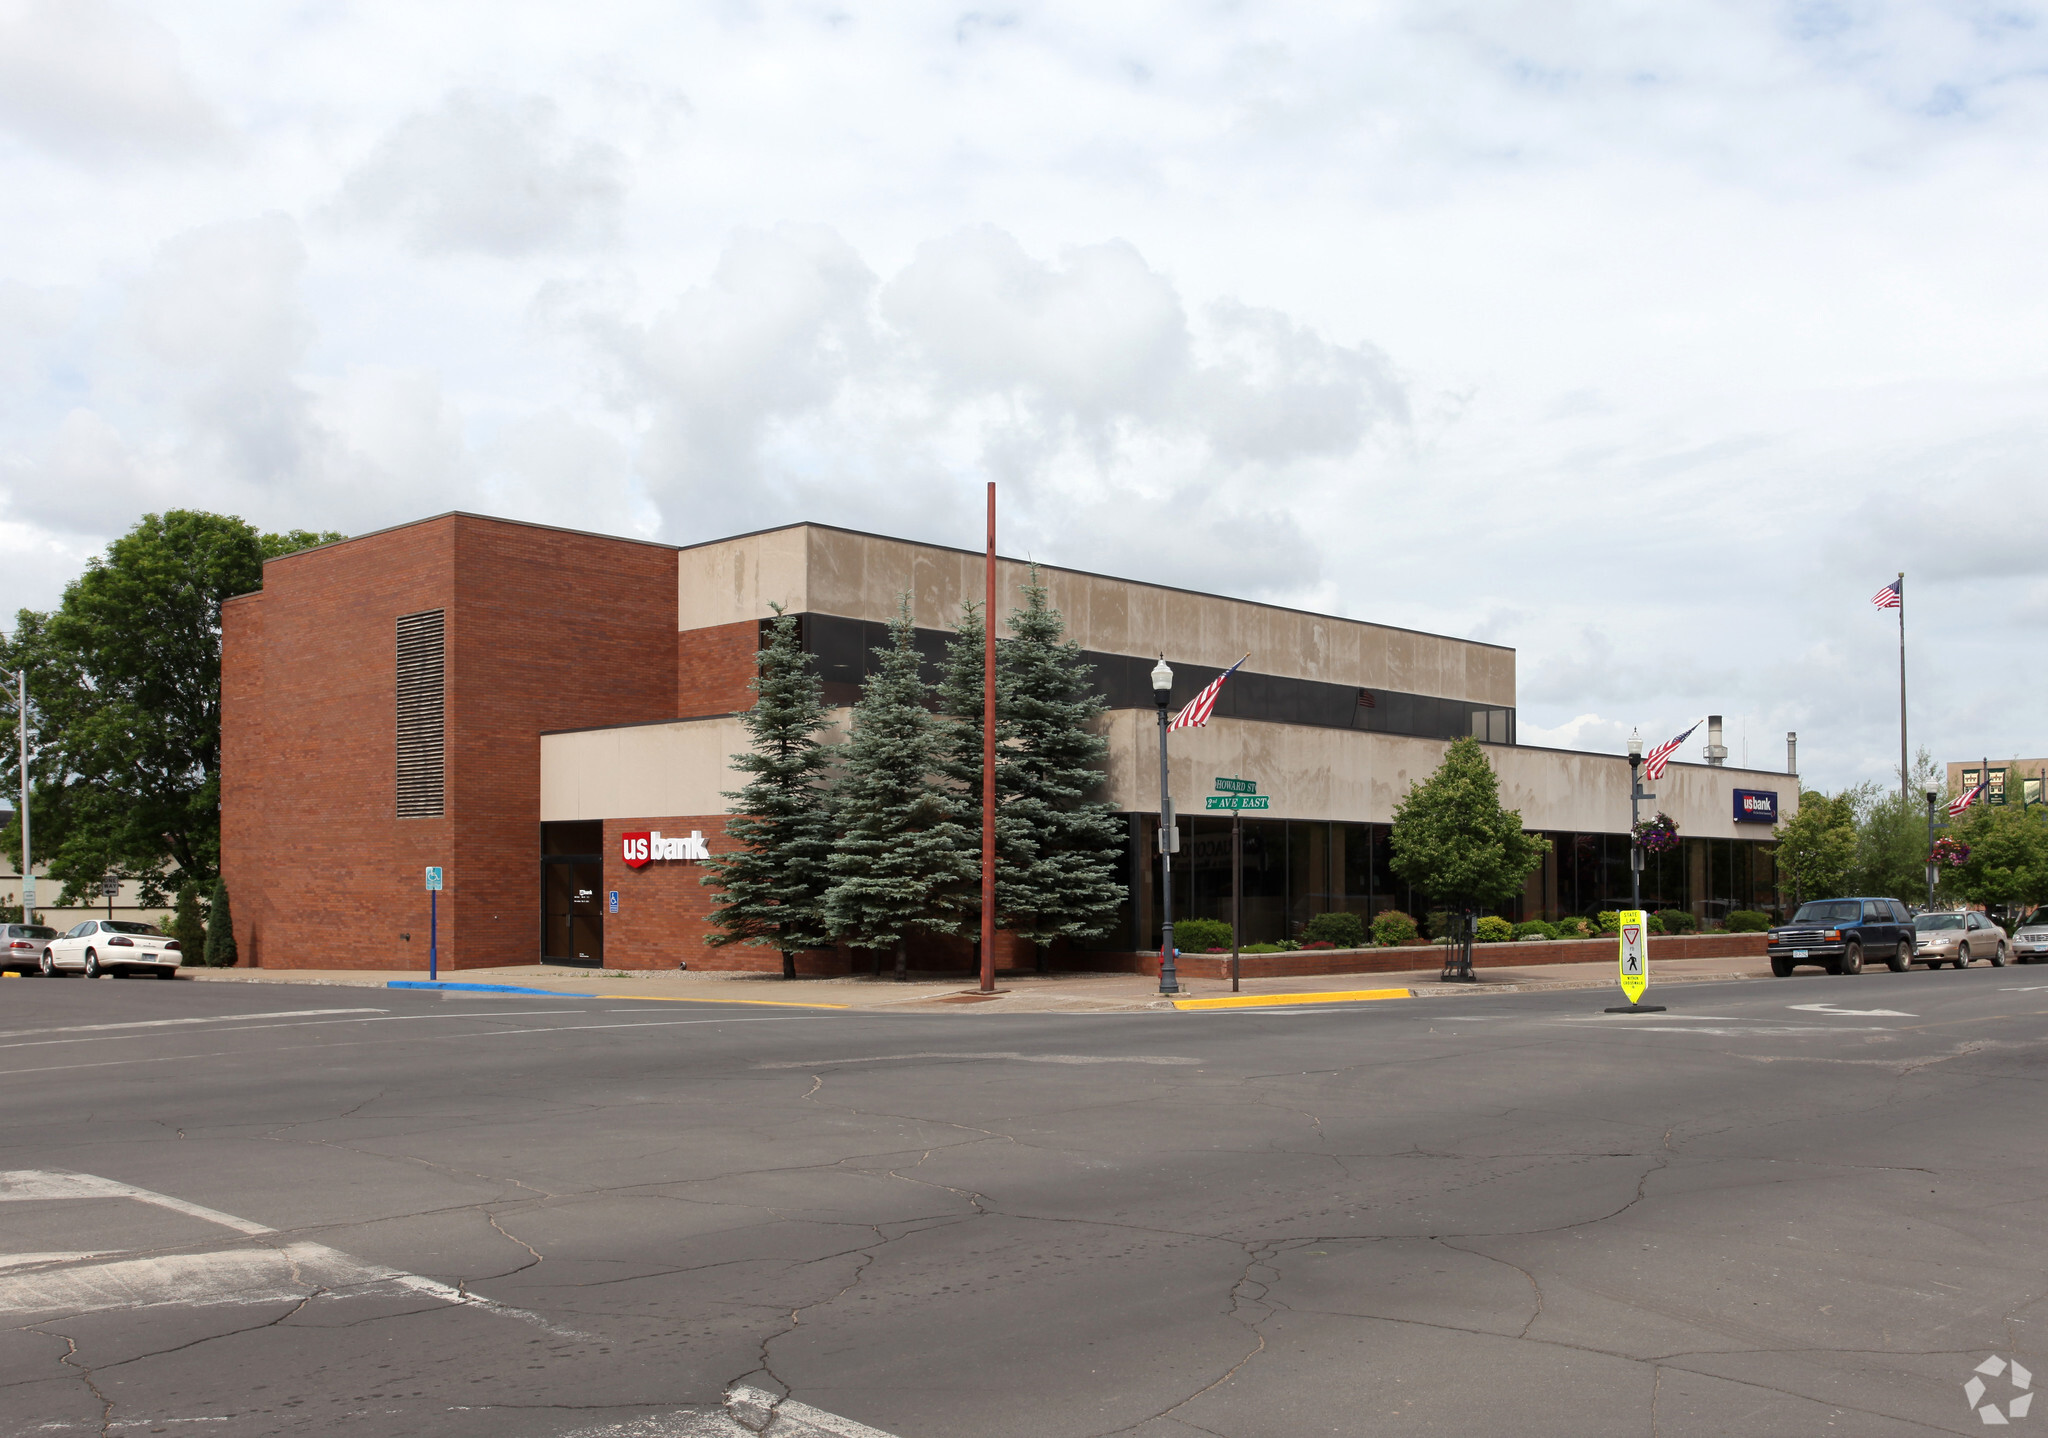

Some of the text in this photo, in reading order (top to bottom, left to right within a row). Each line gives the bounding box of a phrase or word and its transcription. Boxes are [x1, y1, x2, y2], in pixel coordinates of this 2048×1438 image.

[1216, 780, 1256, 792] HOWARD ST
[1219, 798, 1238, 808] AVE
[1242, 798, 1267, 808] EAST
